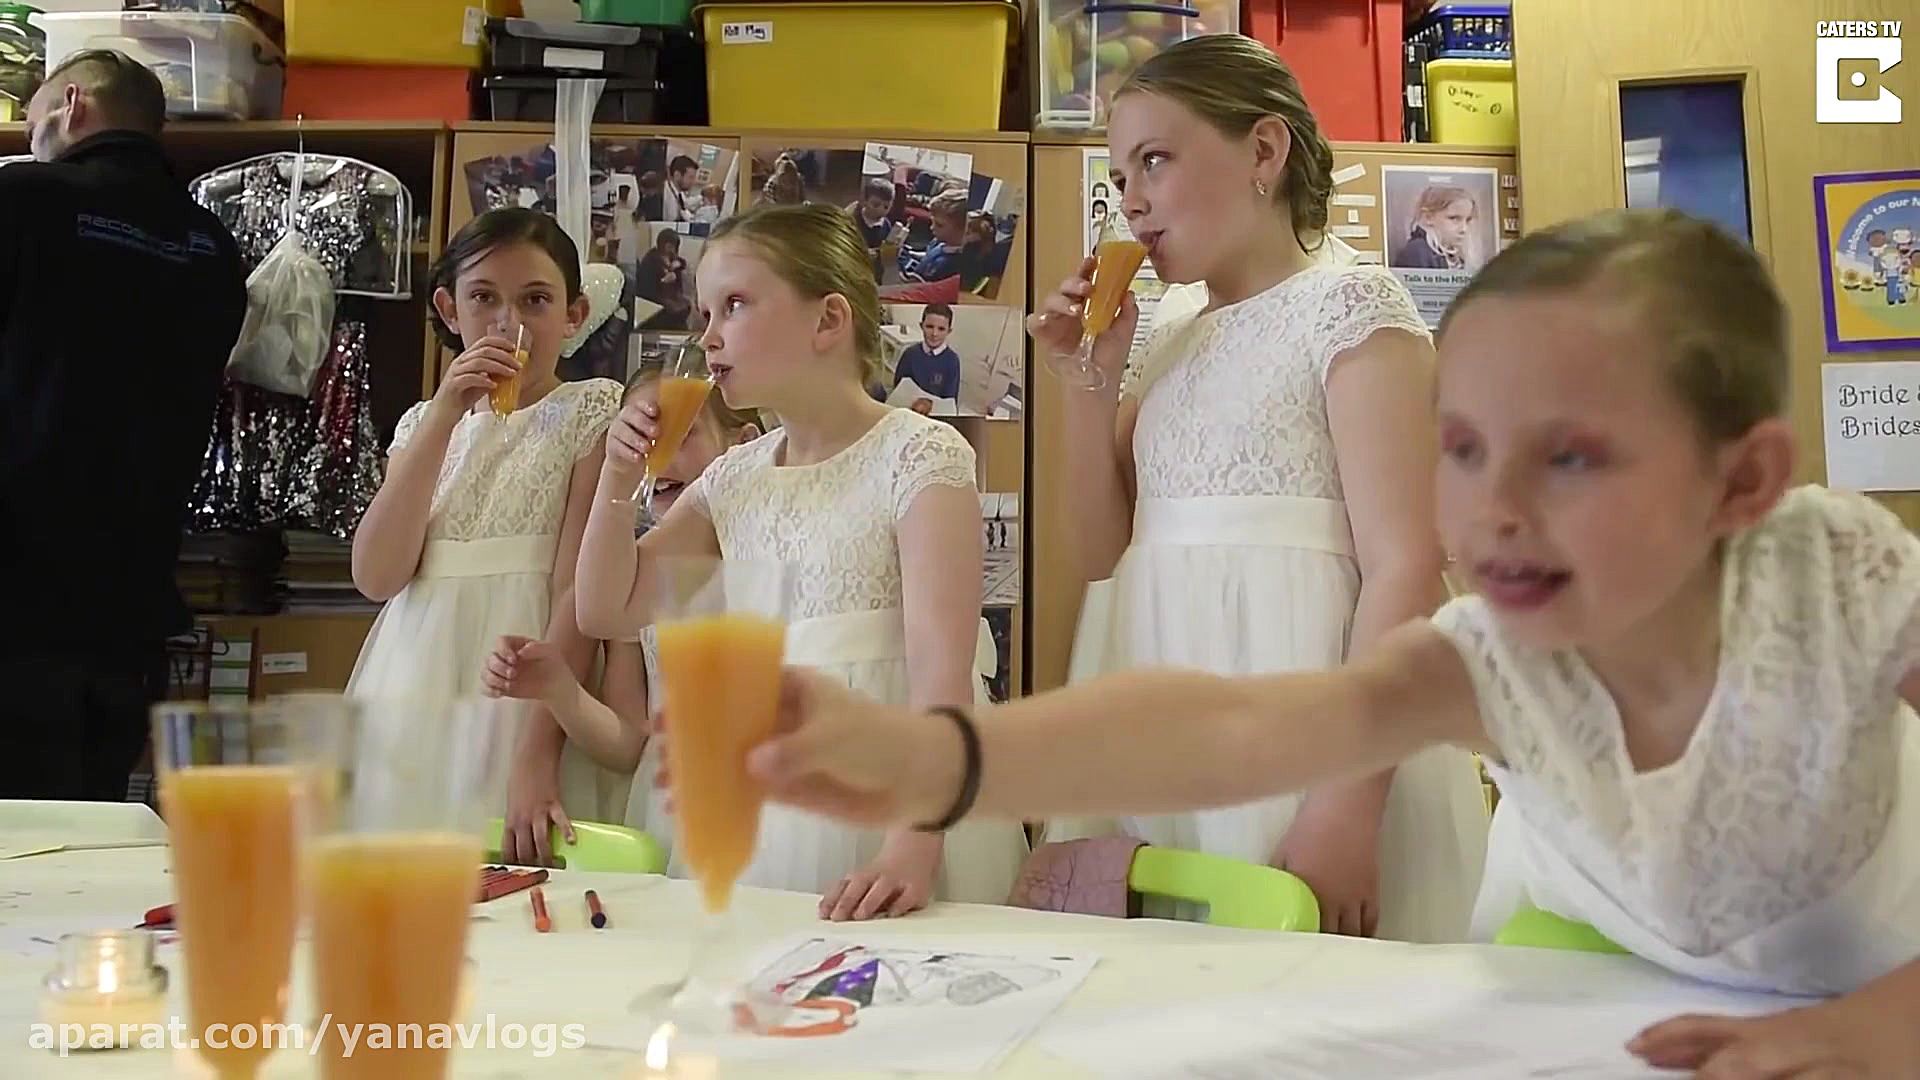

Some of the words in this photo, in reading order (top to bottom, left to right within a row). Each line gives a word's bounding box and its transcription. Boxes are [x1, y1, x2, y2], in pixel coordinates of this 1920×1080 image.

[1873, 205, 1887, 216] to
[1888, 199, 1910, 209] our
[1403, 274, 1421, 283] Talk
[1424, 274, 1433, 283] to
[1435, 274, 1450, 283] the
[1838, 384, 1910, 408] Bride
[1841, 415, 1920, 439] Brides
